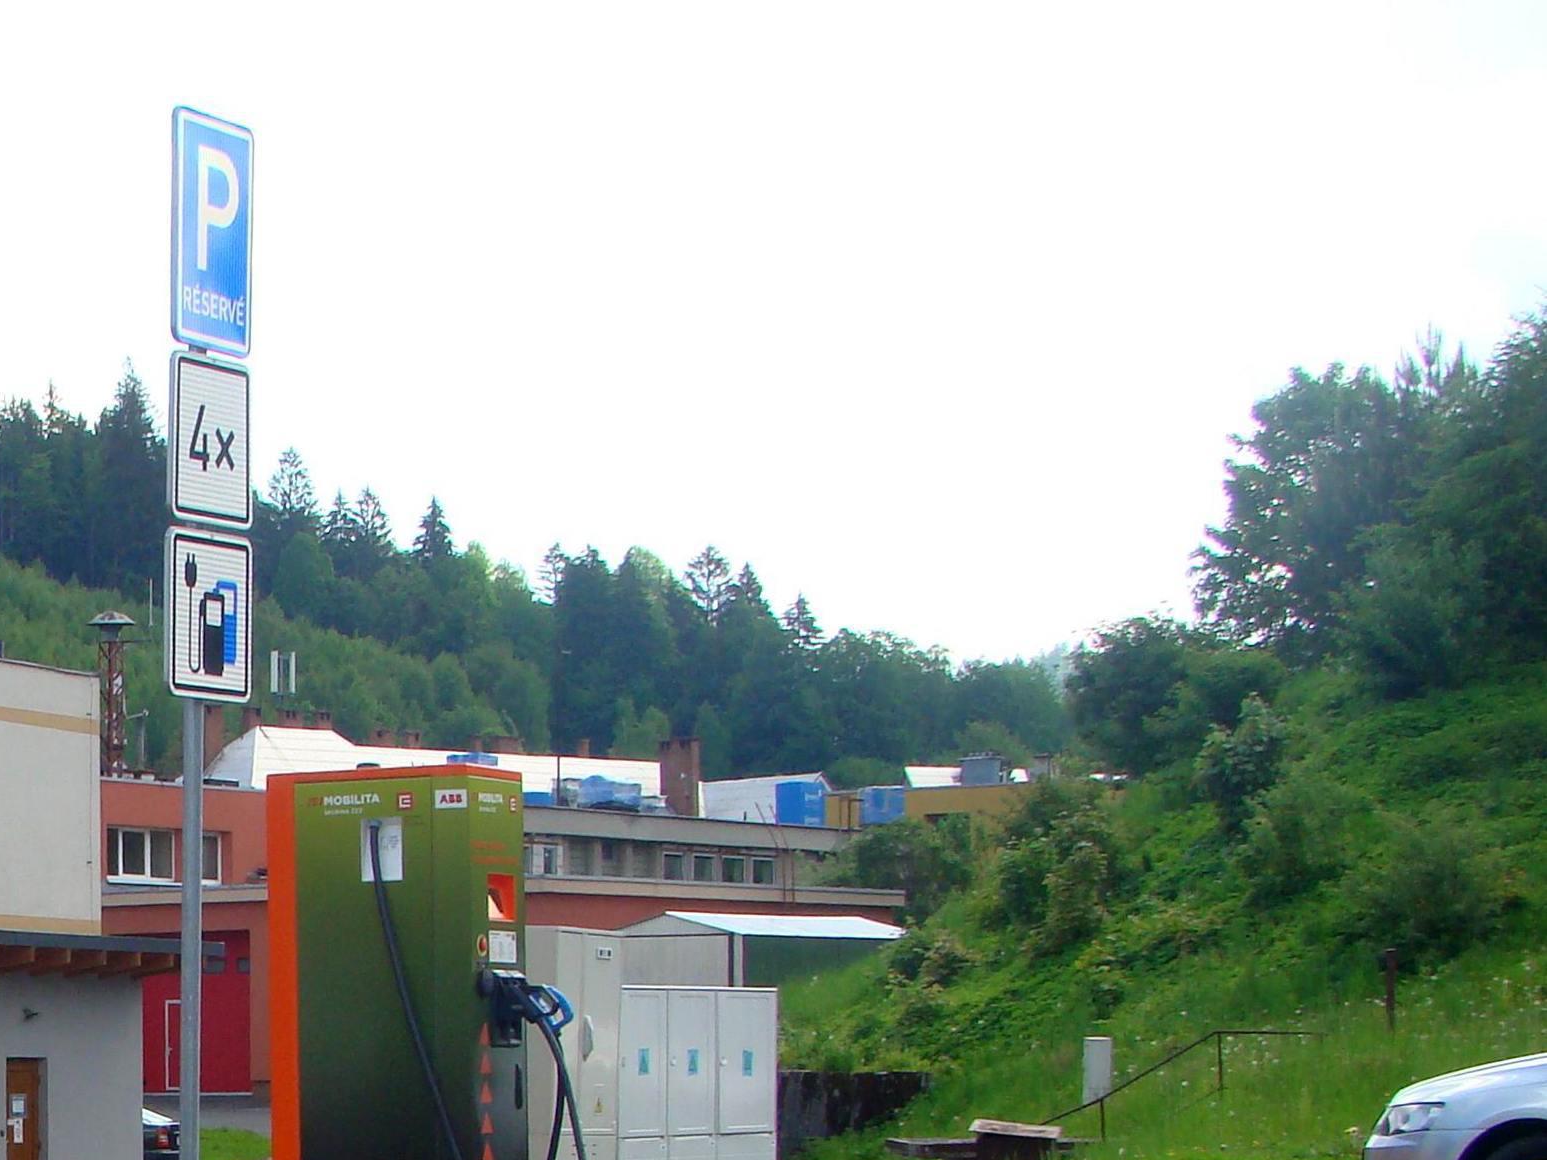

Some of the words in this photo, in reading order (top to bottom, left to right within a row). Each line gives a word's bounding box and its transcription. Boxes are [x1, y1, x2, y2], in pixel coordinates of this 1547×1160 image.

[197, 144, 239, 271] P
[182, 284, 246, 326] RÉSERVÉ
[439, 793, 463, 804] ABB
